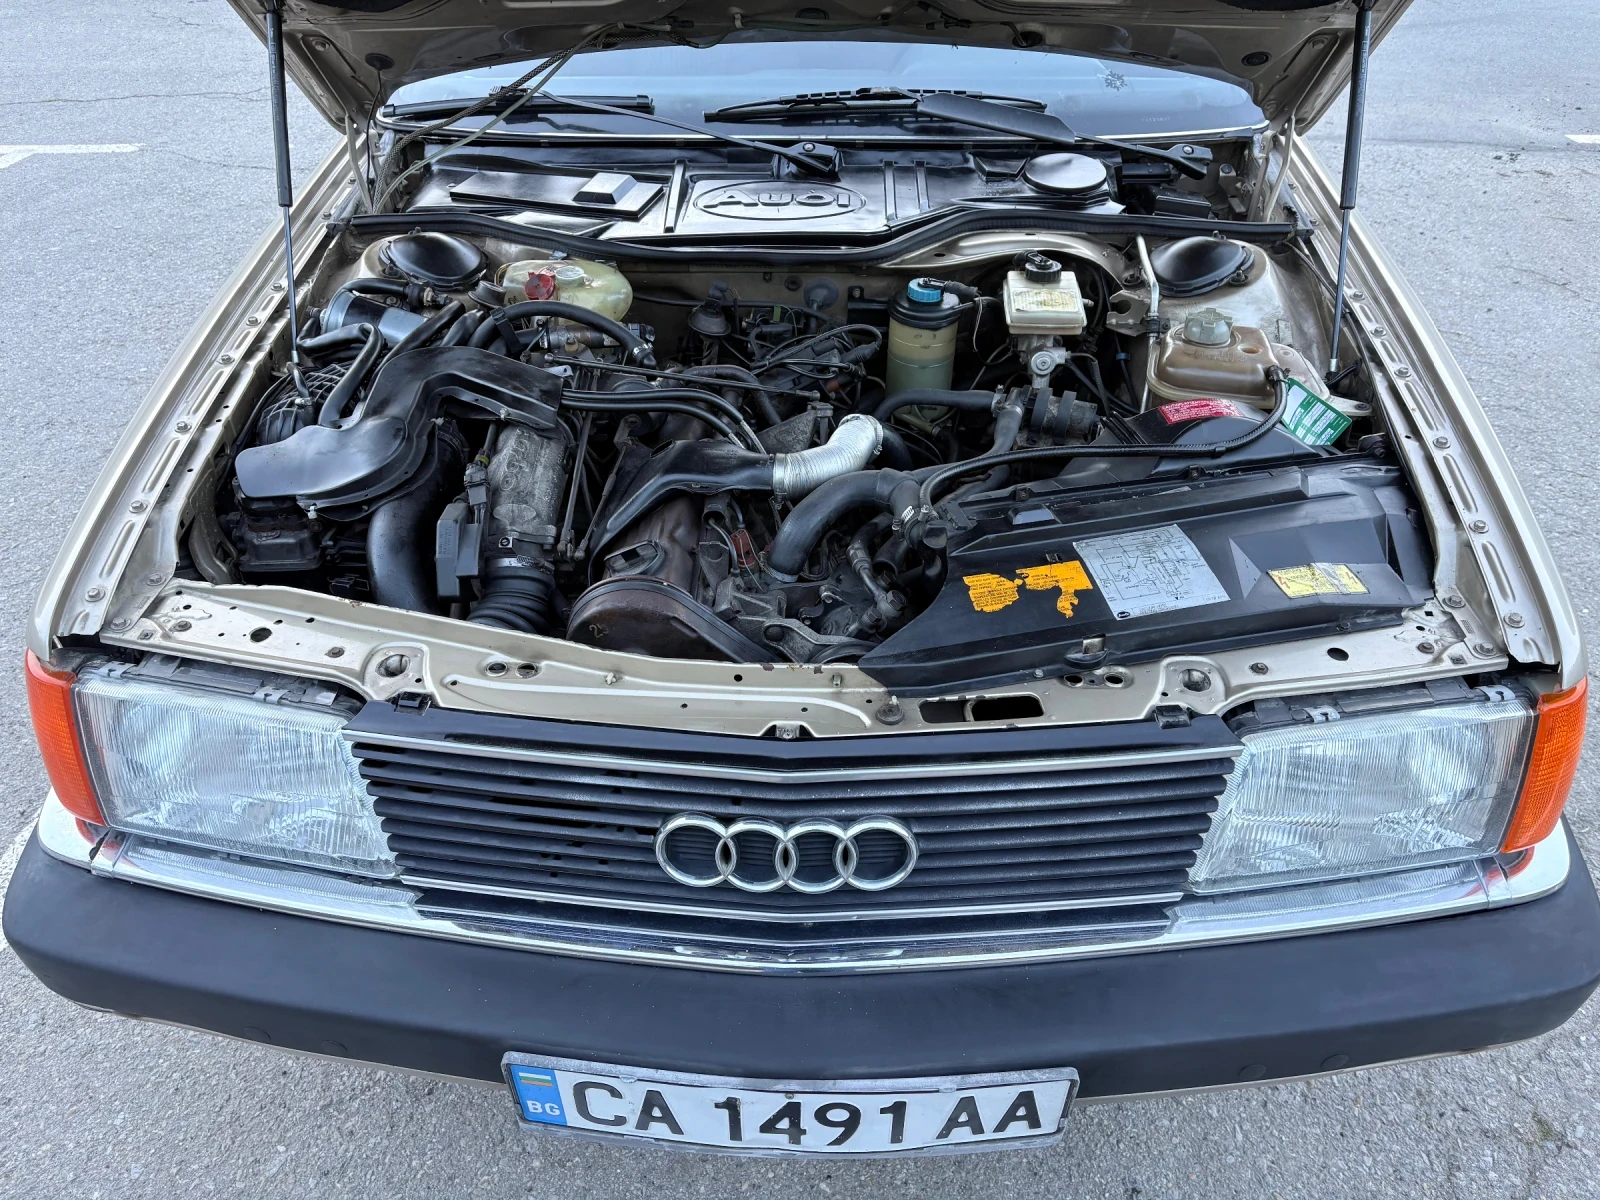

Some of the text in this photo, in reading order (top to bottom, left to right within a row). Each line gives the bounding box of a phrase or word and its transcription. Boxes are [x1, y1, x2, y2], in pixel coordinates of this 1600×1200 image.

[527, 1100, 560, 1116] BG
[573, 1080, 1042, 1146] CA 1491 AA
